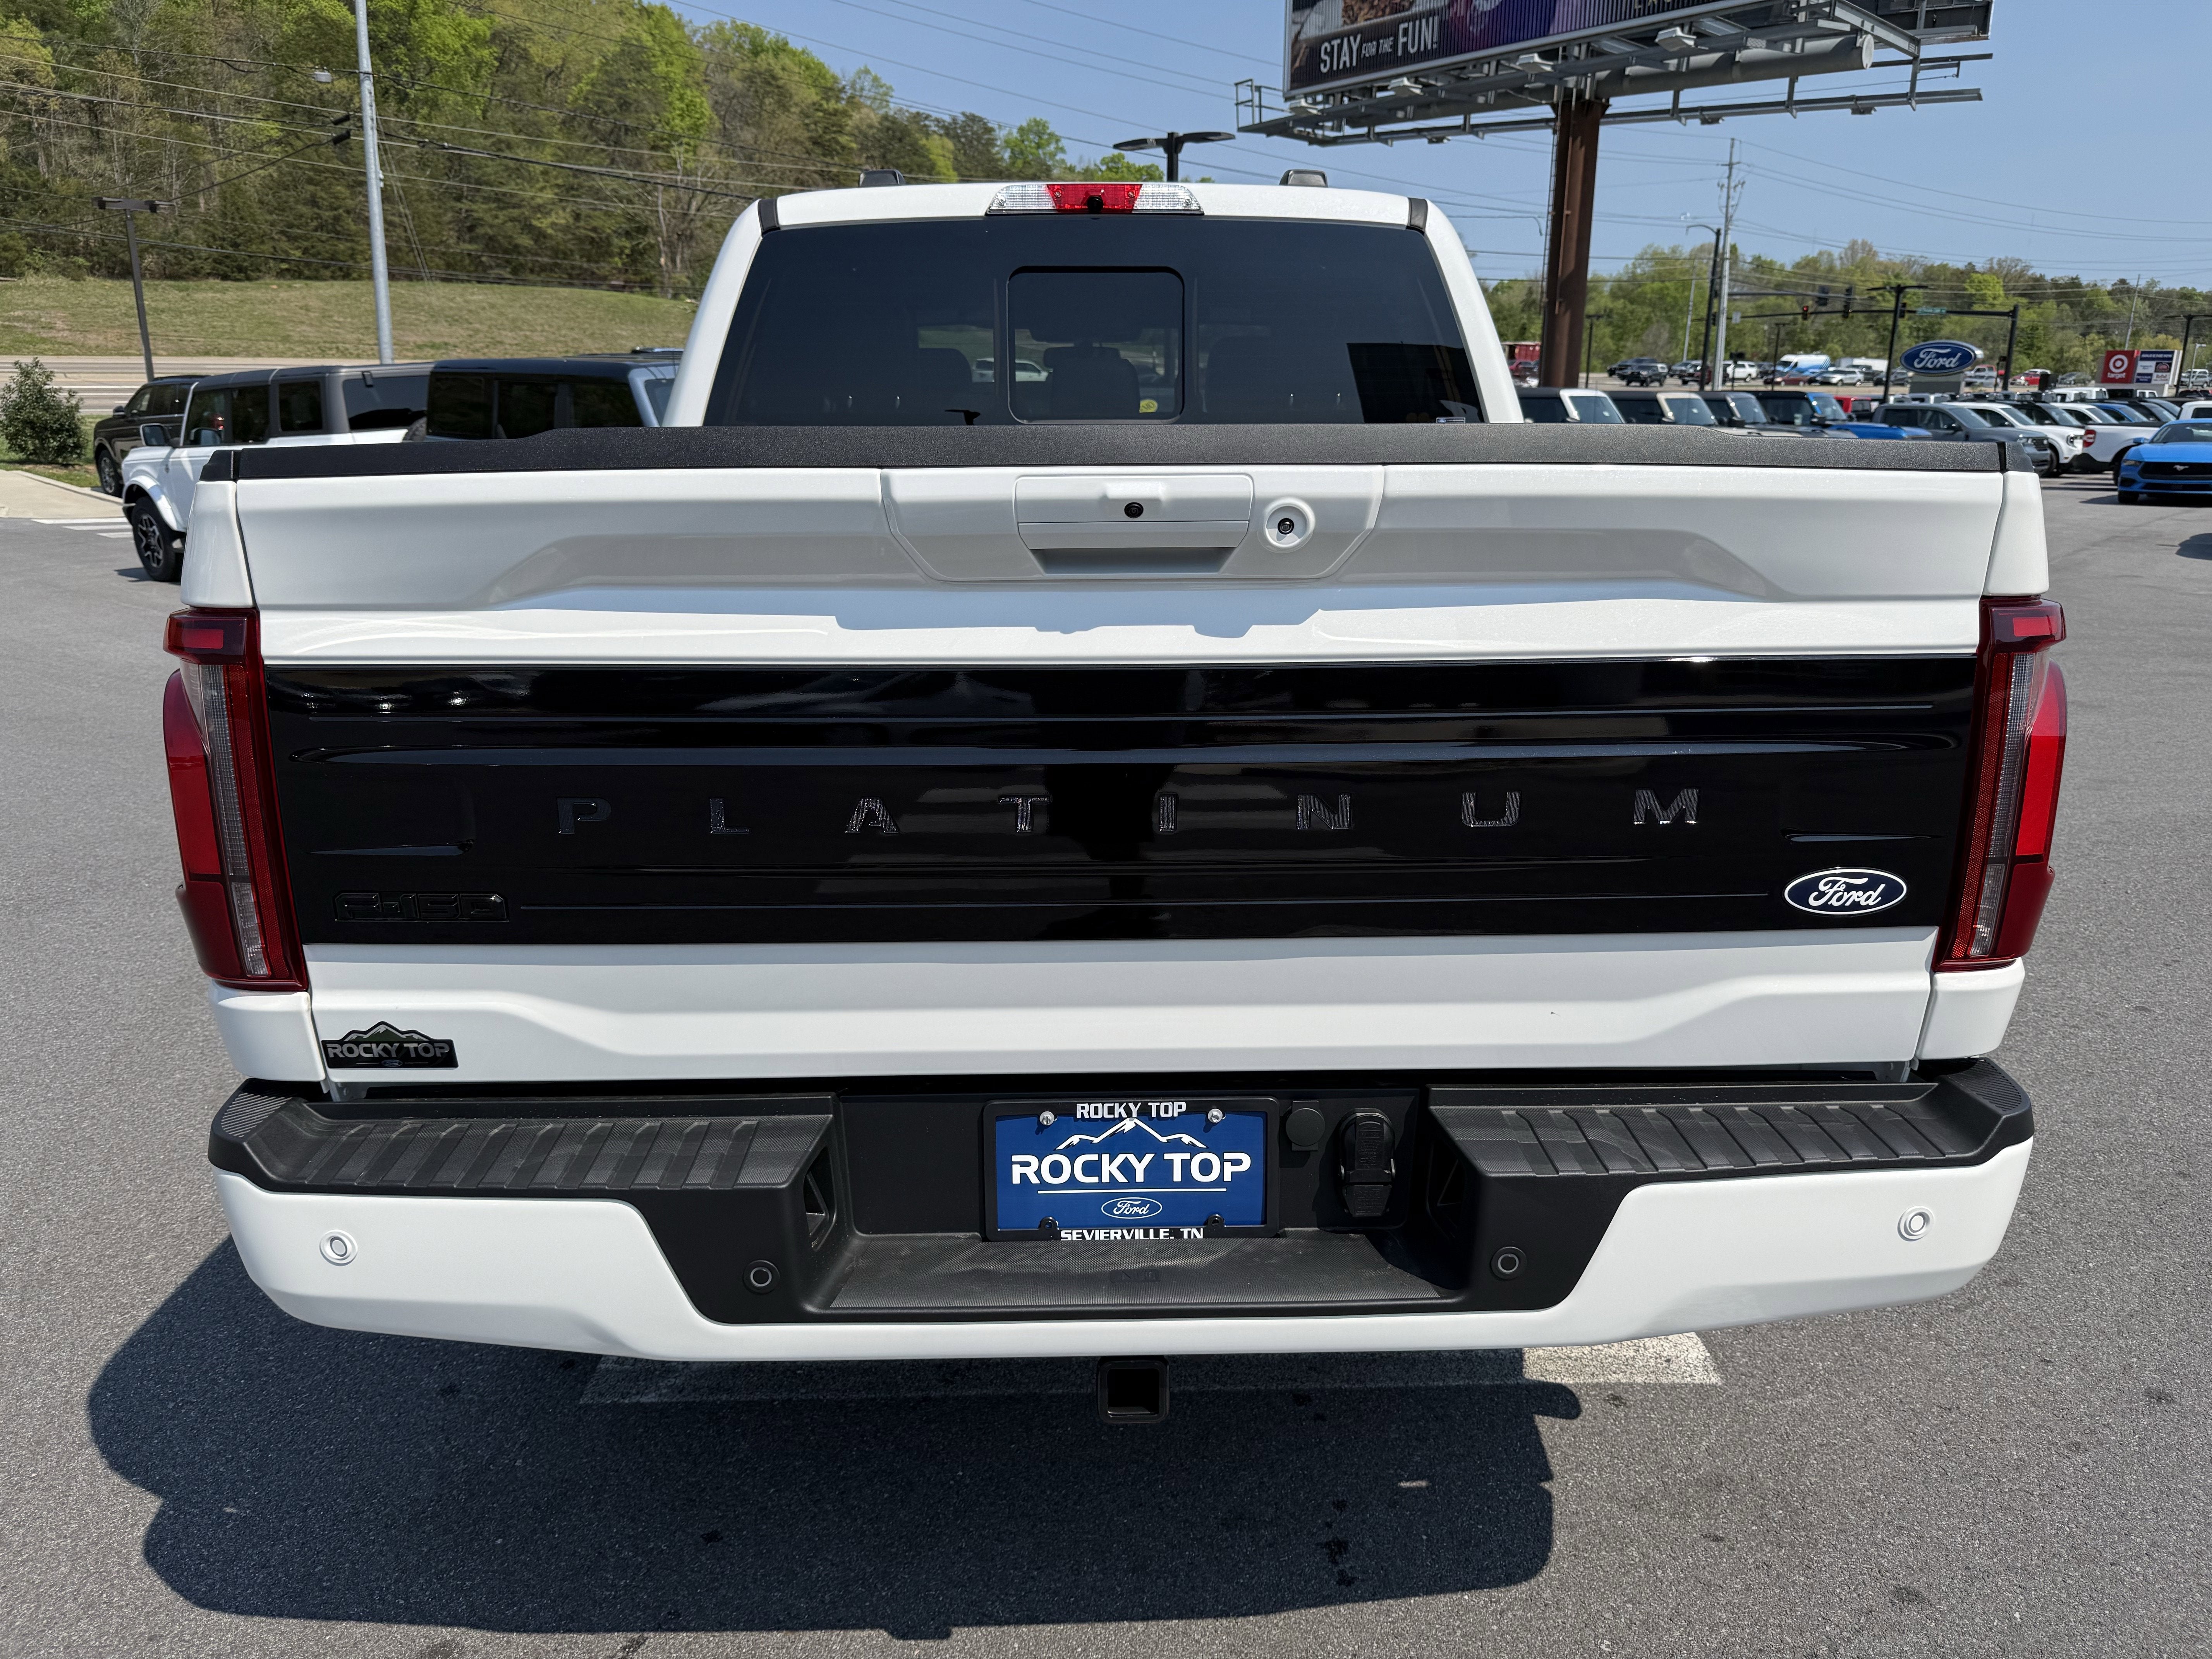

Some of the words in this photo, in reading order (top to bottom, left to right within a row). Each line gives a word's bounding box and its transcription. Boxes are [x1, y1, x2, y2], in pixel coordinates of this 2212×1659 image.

[1320, 34, 1361, 73] STAY
[1360, 40, 1377, 58] FOR
[1378, 37, 1394, 55] THE
[1397, 15, 1438, 57] FUN!
[1913, 348, 1962, 368] Ford
[556, 788, 1700, 835] PLATINUM
[1808, 876, 1886, 907] Ford
[334, 892, 508, 920] F-150
[326, 1043, 400, 1058] ROCKY
[403, 1042, 450, 1058] TOP
[1076, 1102, 1141, 1119] ROCKY
[1148, 1101, 1186, 1118] TOP
[1011, 1153, 1155, 1185] ROCKY
[1164, 1152, 1252, 1183] TOP
[1113, 1200, 1150, 1215] Ford
[1180, 1228, 1203, 1239] TN
